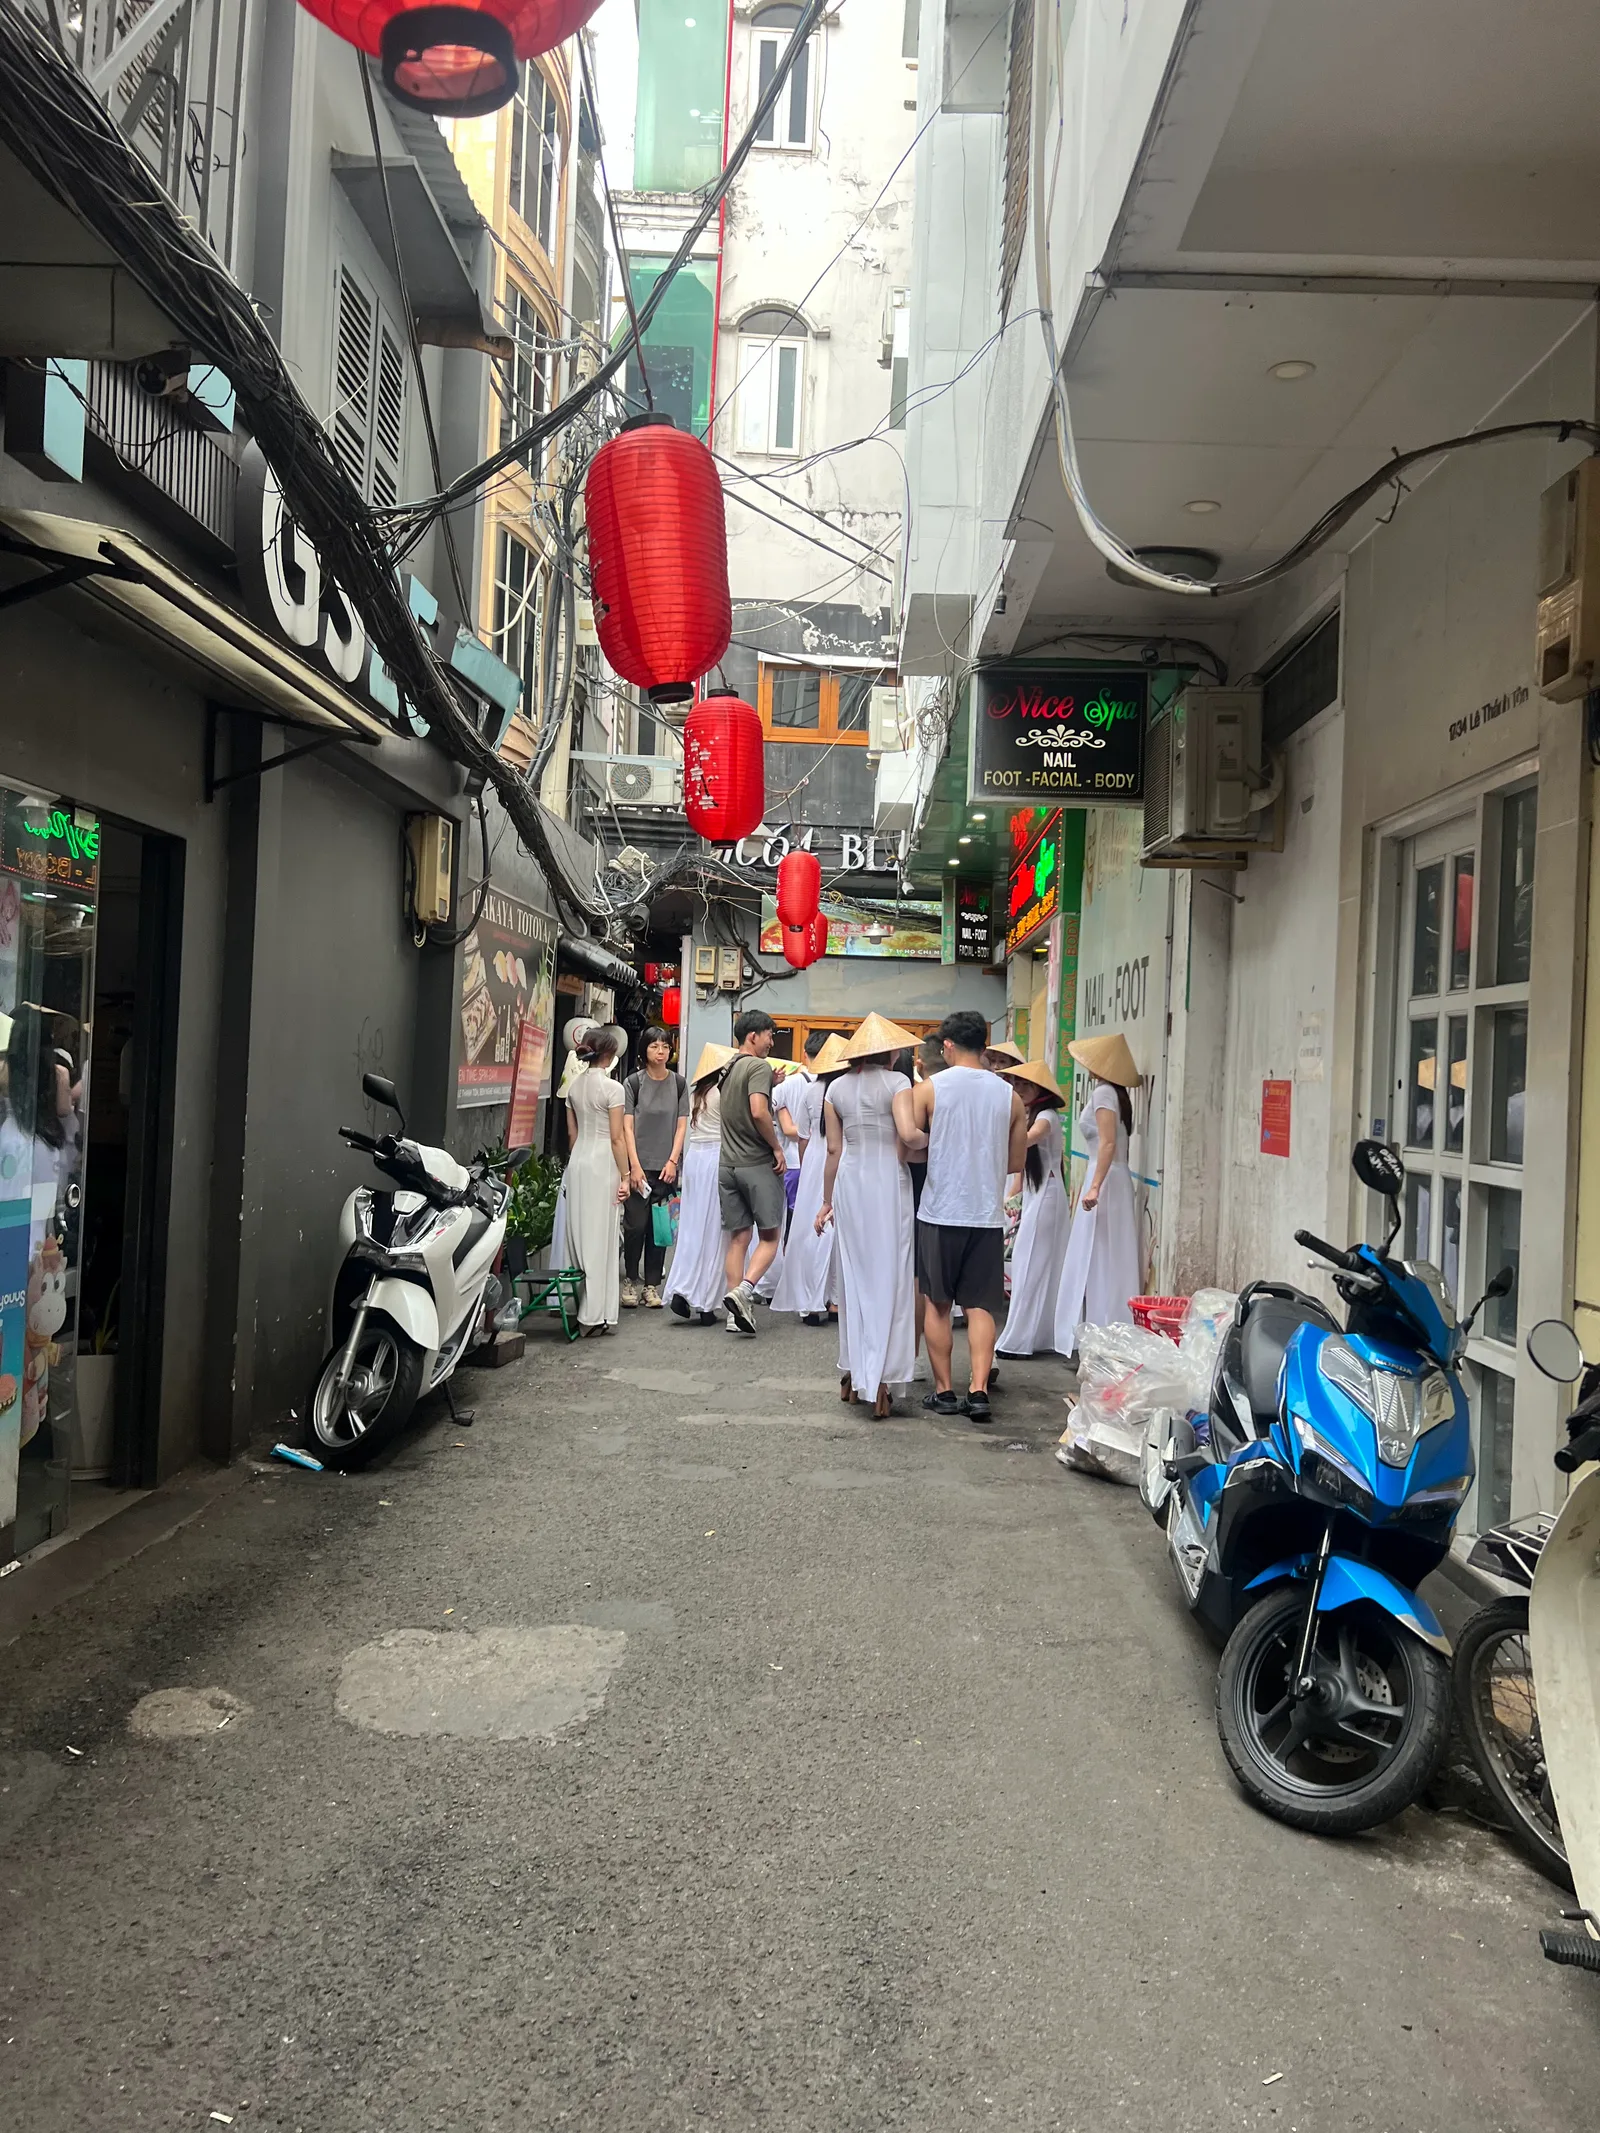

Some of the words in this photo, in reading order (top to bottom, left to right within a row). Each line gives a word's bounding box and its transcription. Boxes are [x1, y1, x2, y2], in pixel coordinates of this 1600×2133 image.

[987, 685, 1074, 719] Nice
[1084, 687, 1138, 731] Spa
[1043, 752, 1076, 768] NAIL
[983, 770, 1022, 787] FOOT
[1094, 773, 1136, 789] BODY
[839, 833, 900, 871] BL
[516, 908, 548, 944] TOTOYA
[961, 928, 973, 940] NAIL
[975, 928, 988, 941] FOOT
[1065, 918, 1080, 957] BODY
[958, 944, 974, 957] FACIAL
[1084, 973, 1106, 1028] NAIL
[1114, 955, 1149, 1023] FOOT
[1375, 1358, 1413, 1376] HONDA
